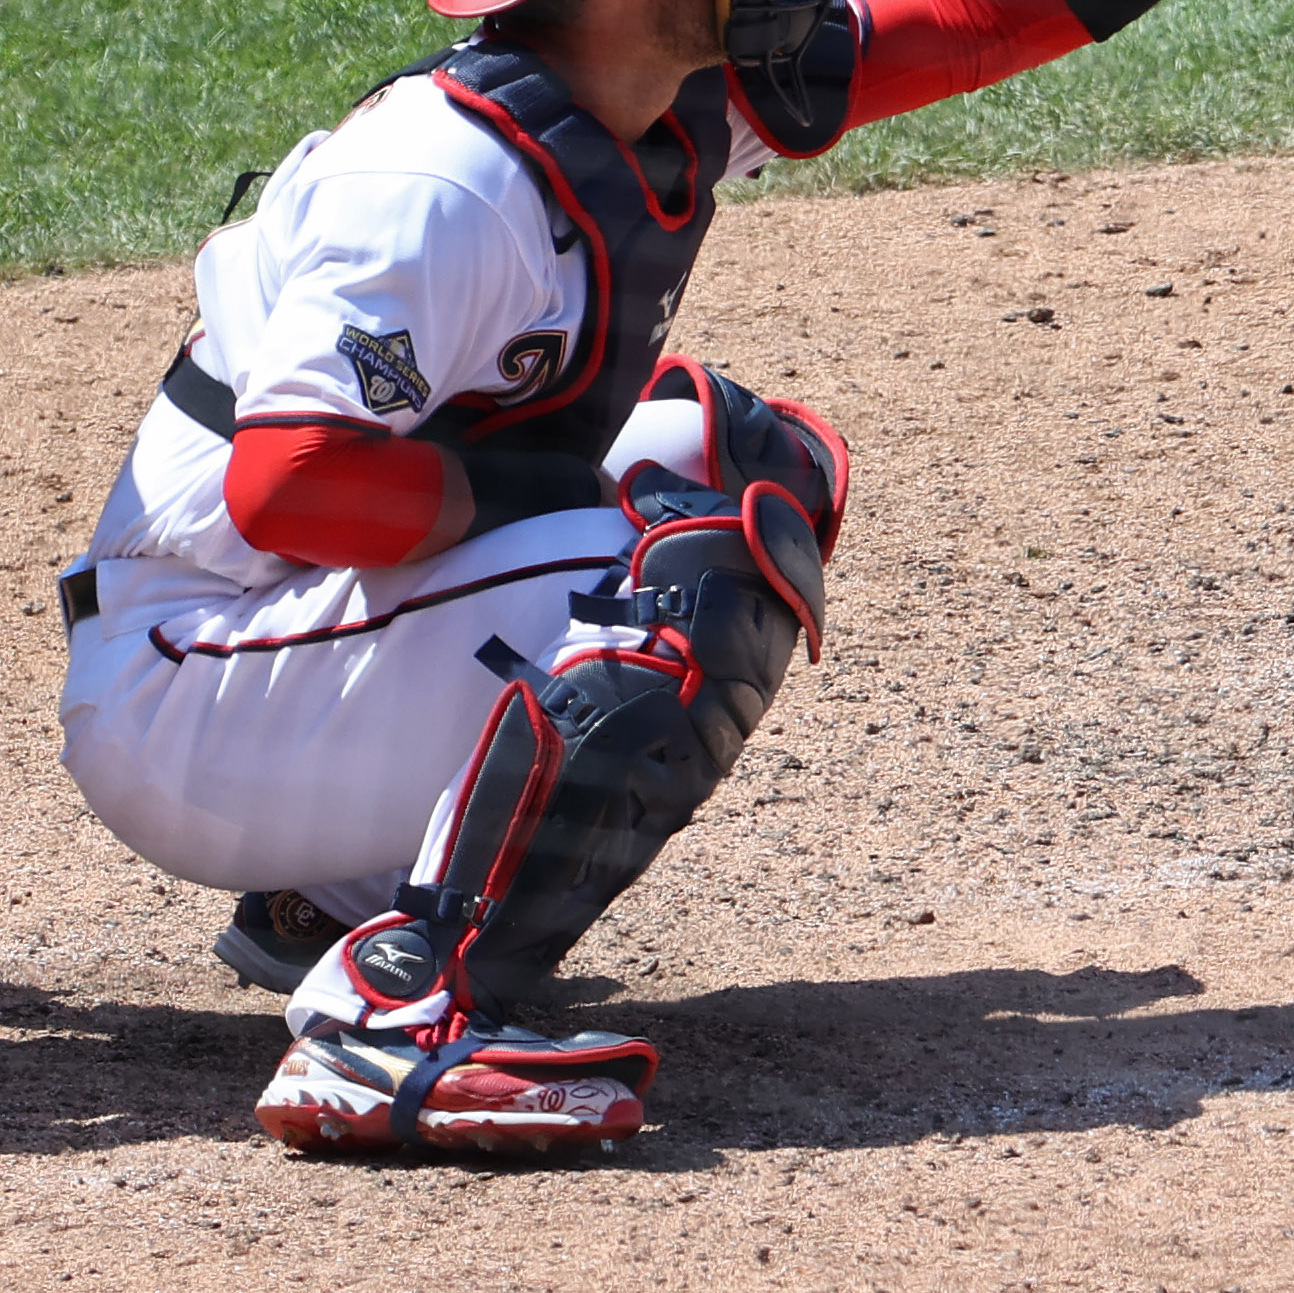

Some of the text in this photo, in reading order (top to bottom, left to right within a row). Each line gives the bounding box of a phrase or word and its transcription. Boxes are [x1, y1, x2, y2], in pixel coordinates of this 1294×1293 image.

[340, 336, 422, 409] CHAMPIONS
[346, 326, 430, 398] WORLD SERIES
[364, 954, 412, 982] MIZUNO
